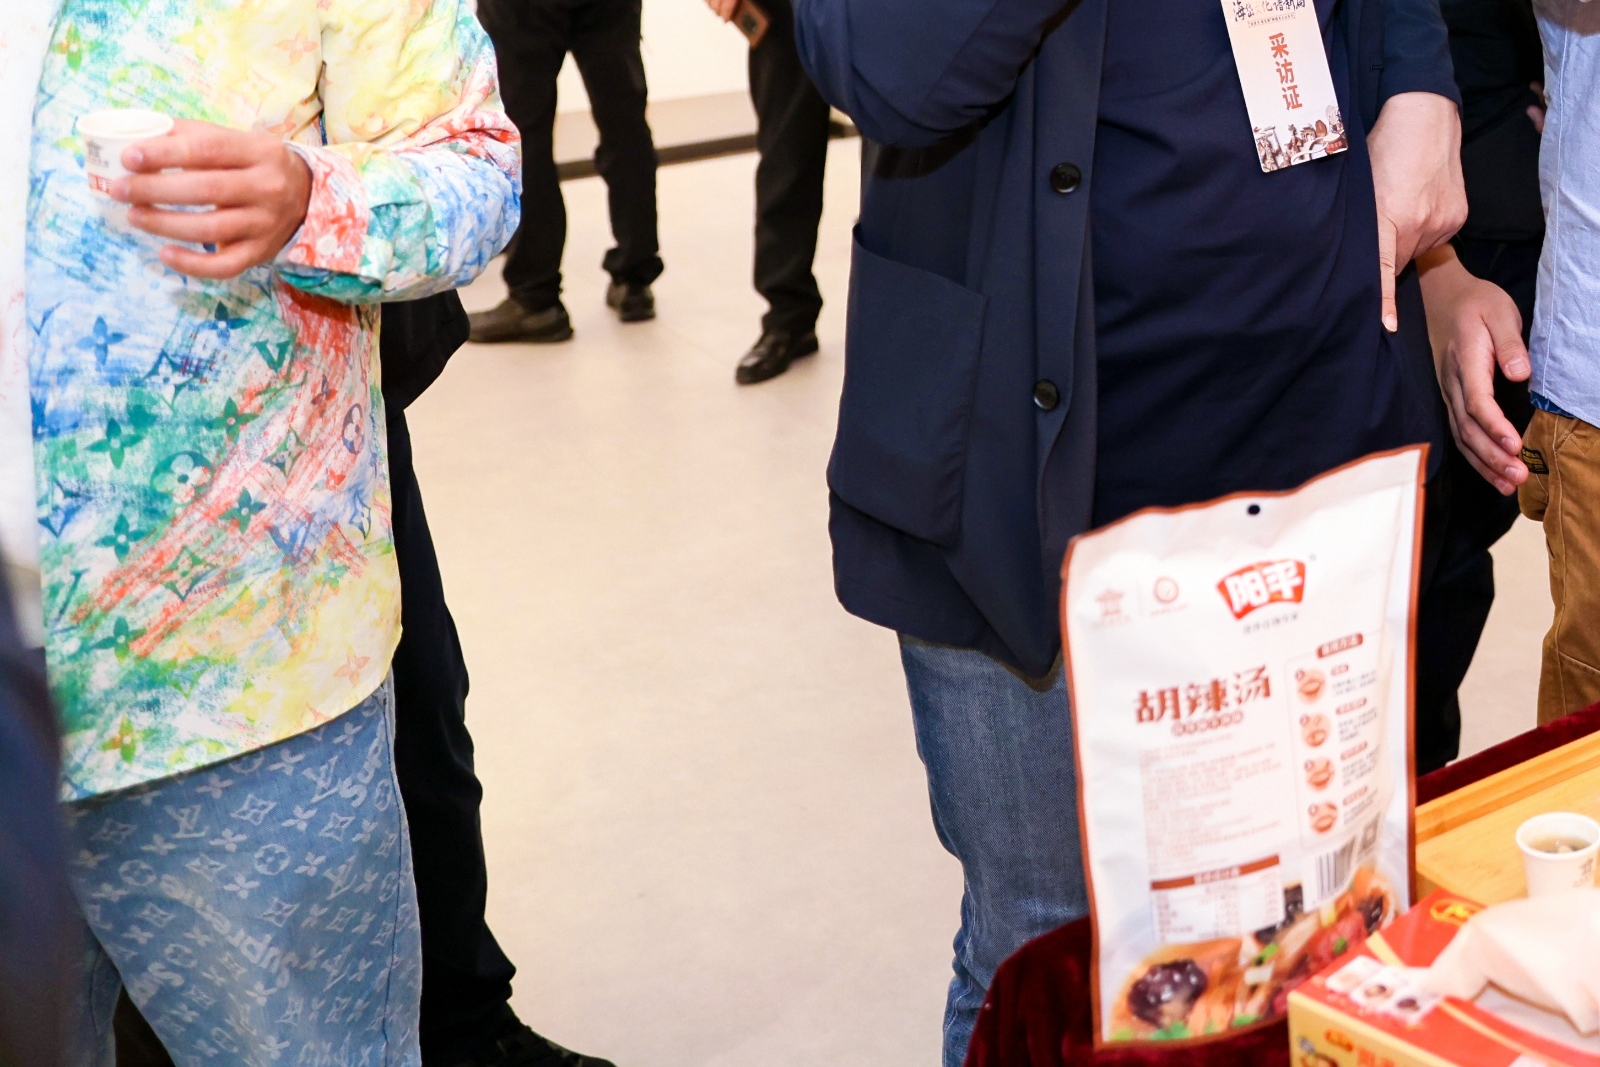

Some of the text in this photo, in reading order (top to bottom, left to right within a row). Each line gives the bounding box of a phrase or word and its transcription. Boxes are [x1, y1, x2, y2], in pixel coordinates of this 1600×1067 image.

[1268, 32, 1303, 111] 采访证
[1223, 561, 1302, 613] 阳平
[1134, 664, 1271, 724] 胡辣汤
